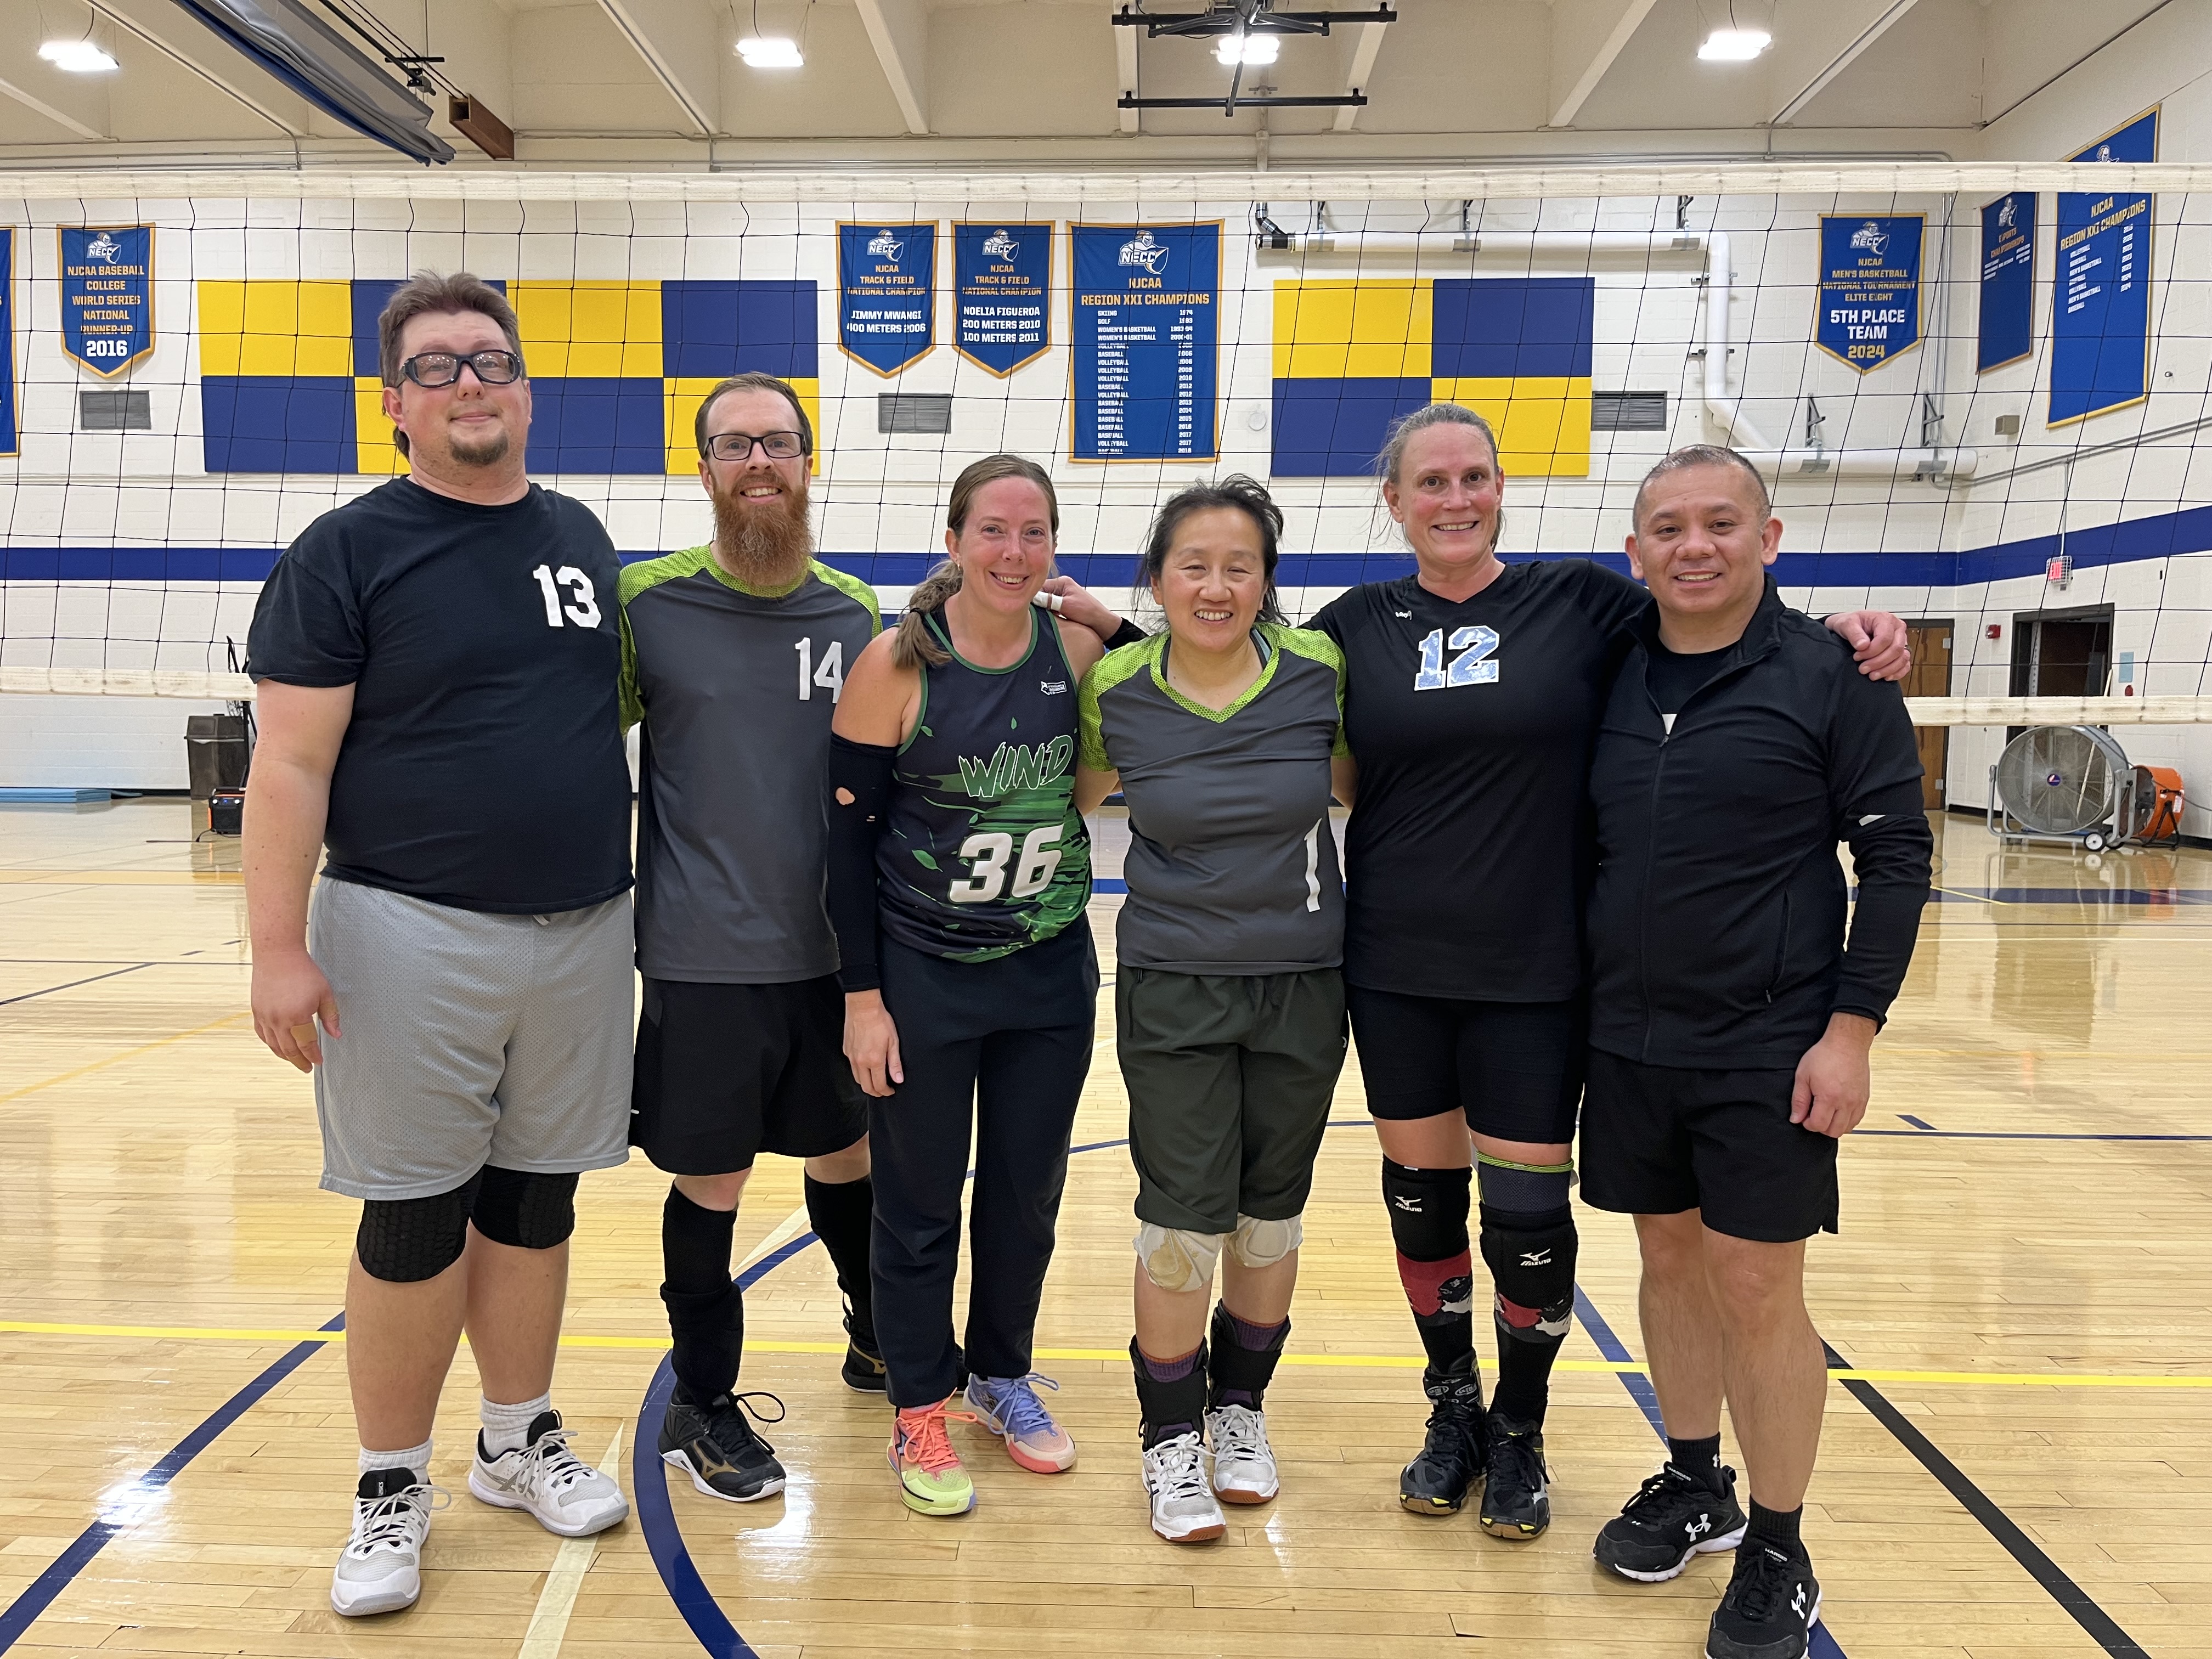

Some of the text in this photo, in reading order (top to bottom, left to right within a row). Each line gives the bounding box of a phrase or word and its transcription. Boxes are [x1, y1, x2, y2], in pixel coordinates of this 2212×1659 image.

[2091, 196, 2113, 218] NJCAA
[2061, 228, 2086, 251] REGION
[2101, 199, 2146, 232] CHAMPIONS
[1853, 238, 1879, 246] NECC
[89, 248, 112, 256] NECC
[869, 245, 894, 254] NECC
[984, 245, 1009, 254] NECC
[1121, 252, 1156, 263] NECC
[1858, 258, 1882, 266] NJCAA
[67, 266, 144, 275] NJCAA BASEBALL
[1832, 269, 1908, 278] MEN'S BASKETBALL
[87, 281, 126, 290] COLLEGE
[1129, 278, 1161, 289] NJCAA
[1822, 281, 1916, 290] NATIONAL TOURNAMENT
[848, 287, 884, 295] NATIONAL
[963, 287, 999, 295] NATIONAL
[72, 295, 140, 305] WORLD SERIES
[1081, 294, 1210, 305] REGION XXI CHAMPIONS
[83, 311, 129, 320] NATIONAL
[851, 311, 922, 319] JIMMY MWANGI
[964, 306, 1040, 316] NOELIA FIGUEROA
[1830, 309, 1905, 323] 5TH PLACE
[847, 323, 926, 332] 400 METERS 2006
[963, 319, 1040, 329] 200 METERS 2010
[81, 325, 133, 335] RUNNER-UP
[1847, 325, 1887, 339] TEAM
[964, 332, 1039, 342] 100 METERS 2011
[87, 340, 127, 357] 2016
[1848, 346, 1885, 358] 2024
[533, 565, 602, 629] 13
[1414, 625, 1500, 691] 12
[795, 637, 843, 704] 14
[959, 735, 1073, 798] WIND
[948, 823, 1064, 904] 36
[1304, 817, 1322, 912] 1
